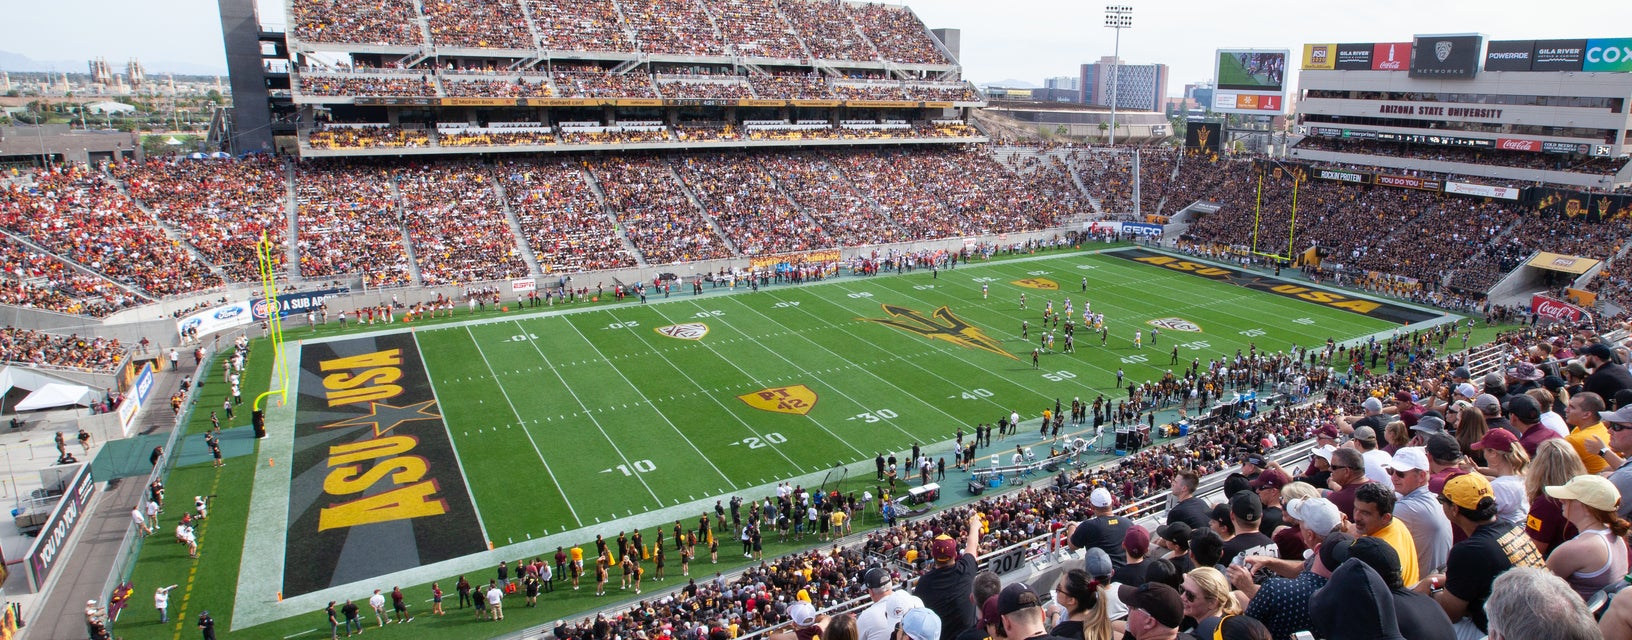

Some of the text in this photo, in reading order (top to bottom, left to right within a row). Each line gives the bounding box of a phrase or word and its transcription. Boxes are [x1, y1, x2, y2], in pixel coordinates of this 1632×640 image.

[1587, 46, 1632, 63] COX
[1379, 104, 1503, 119] ARIZONA STATE UNIVERSITY
[1597, 146, 1609, 155] 34
[1340, 172, 1362, 182] PROTEIN
[1380, 176, 1393, 184] YOU
[1123, 225, 1162, 236] GEICO
[1133, 256, 1233, 276] ASU
[283, 300, 291, 311] A
[291, 296, 310, 310] SUB
[1270, 285, 1383, 313] USA
[1120, 355, 1150, 364] 40
[1041, 370, 1078, 382] 50
[961, 388, 995, 400] 40
[857, 408, 899, 424] 30
[318, 348, 450, 533] ASU USA
[743, 432, 788, 449] 20
[616, 459, 657, 477] 10
[39, 499, 78, 569] YOU DO YOU
[993, 551, 1023, 574] 207
